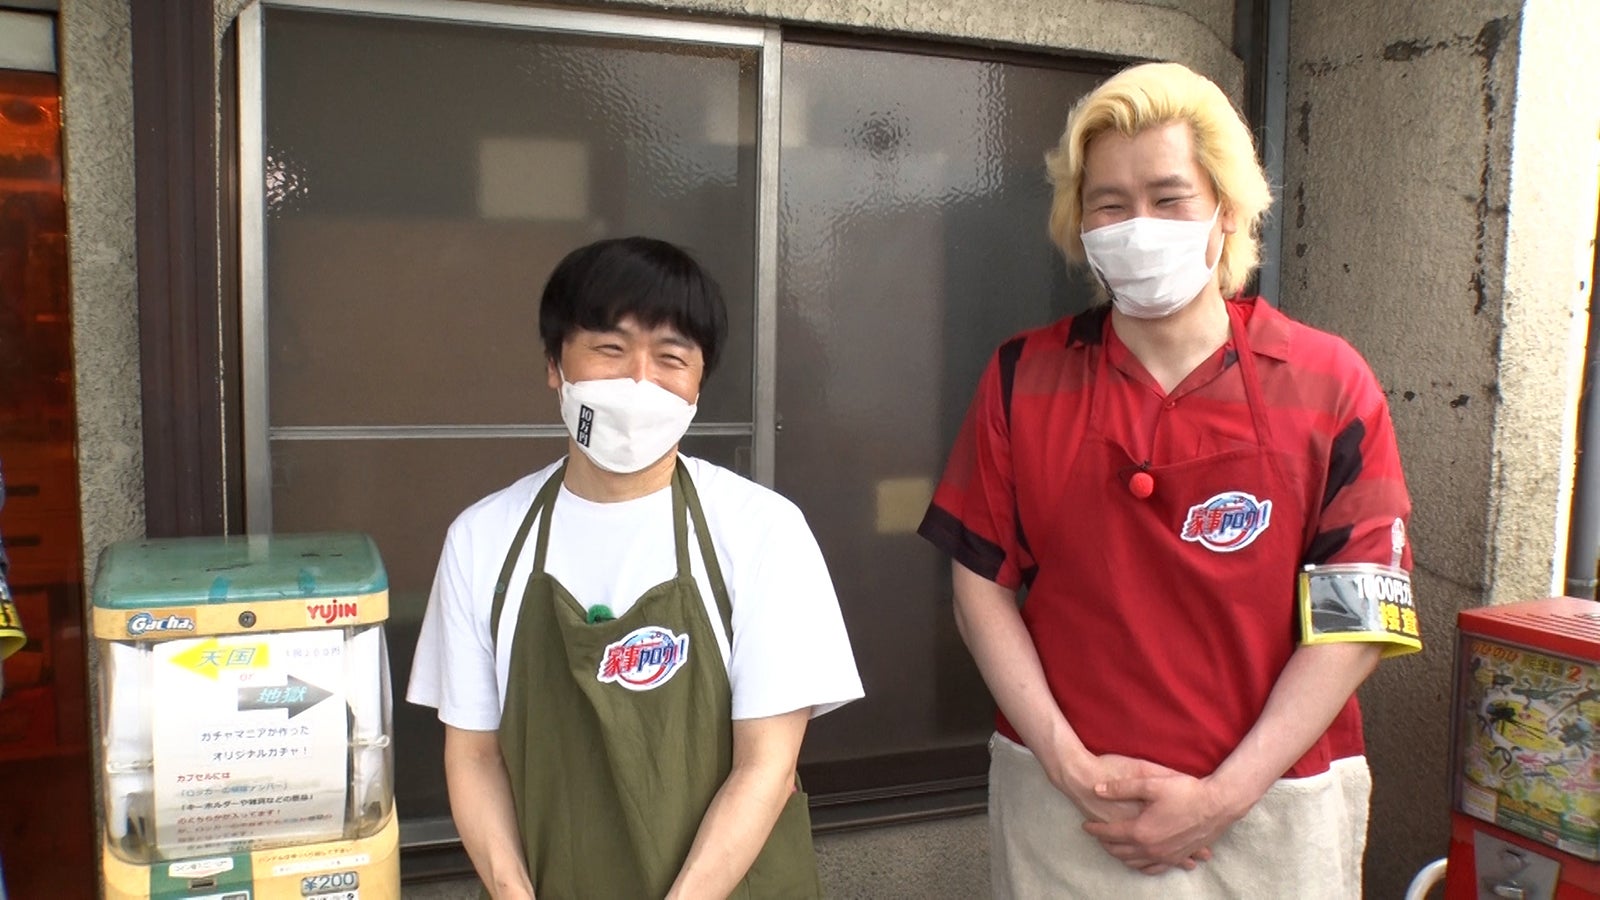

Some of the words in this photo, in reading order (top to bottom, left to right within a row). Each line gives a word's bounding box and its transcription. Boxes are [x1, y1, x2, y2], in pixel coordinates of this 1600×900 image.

[199, 648, 256, 667] 天国
[239, 673, 253, 681] or
[256, 686, 307, 704] 地獄
[201, 726, 310, 742] ガチャマニアが作った
[304, 871, 355, 891] ¥200
